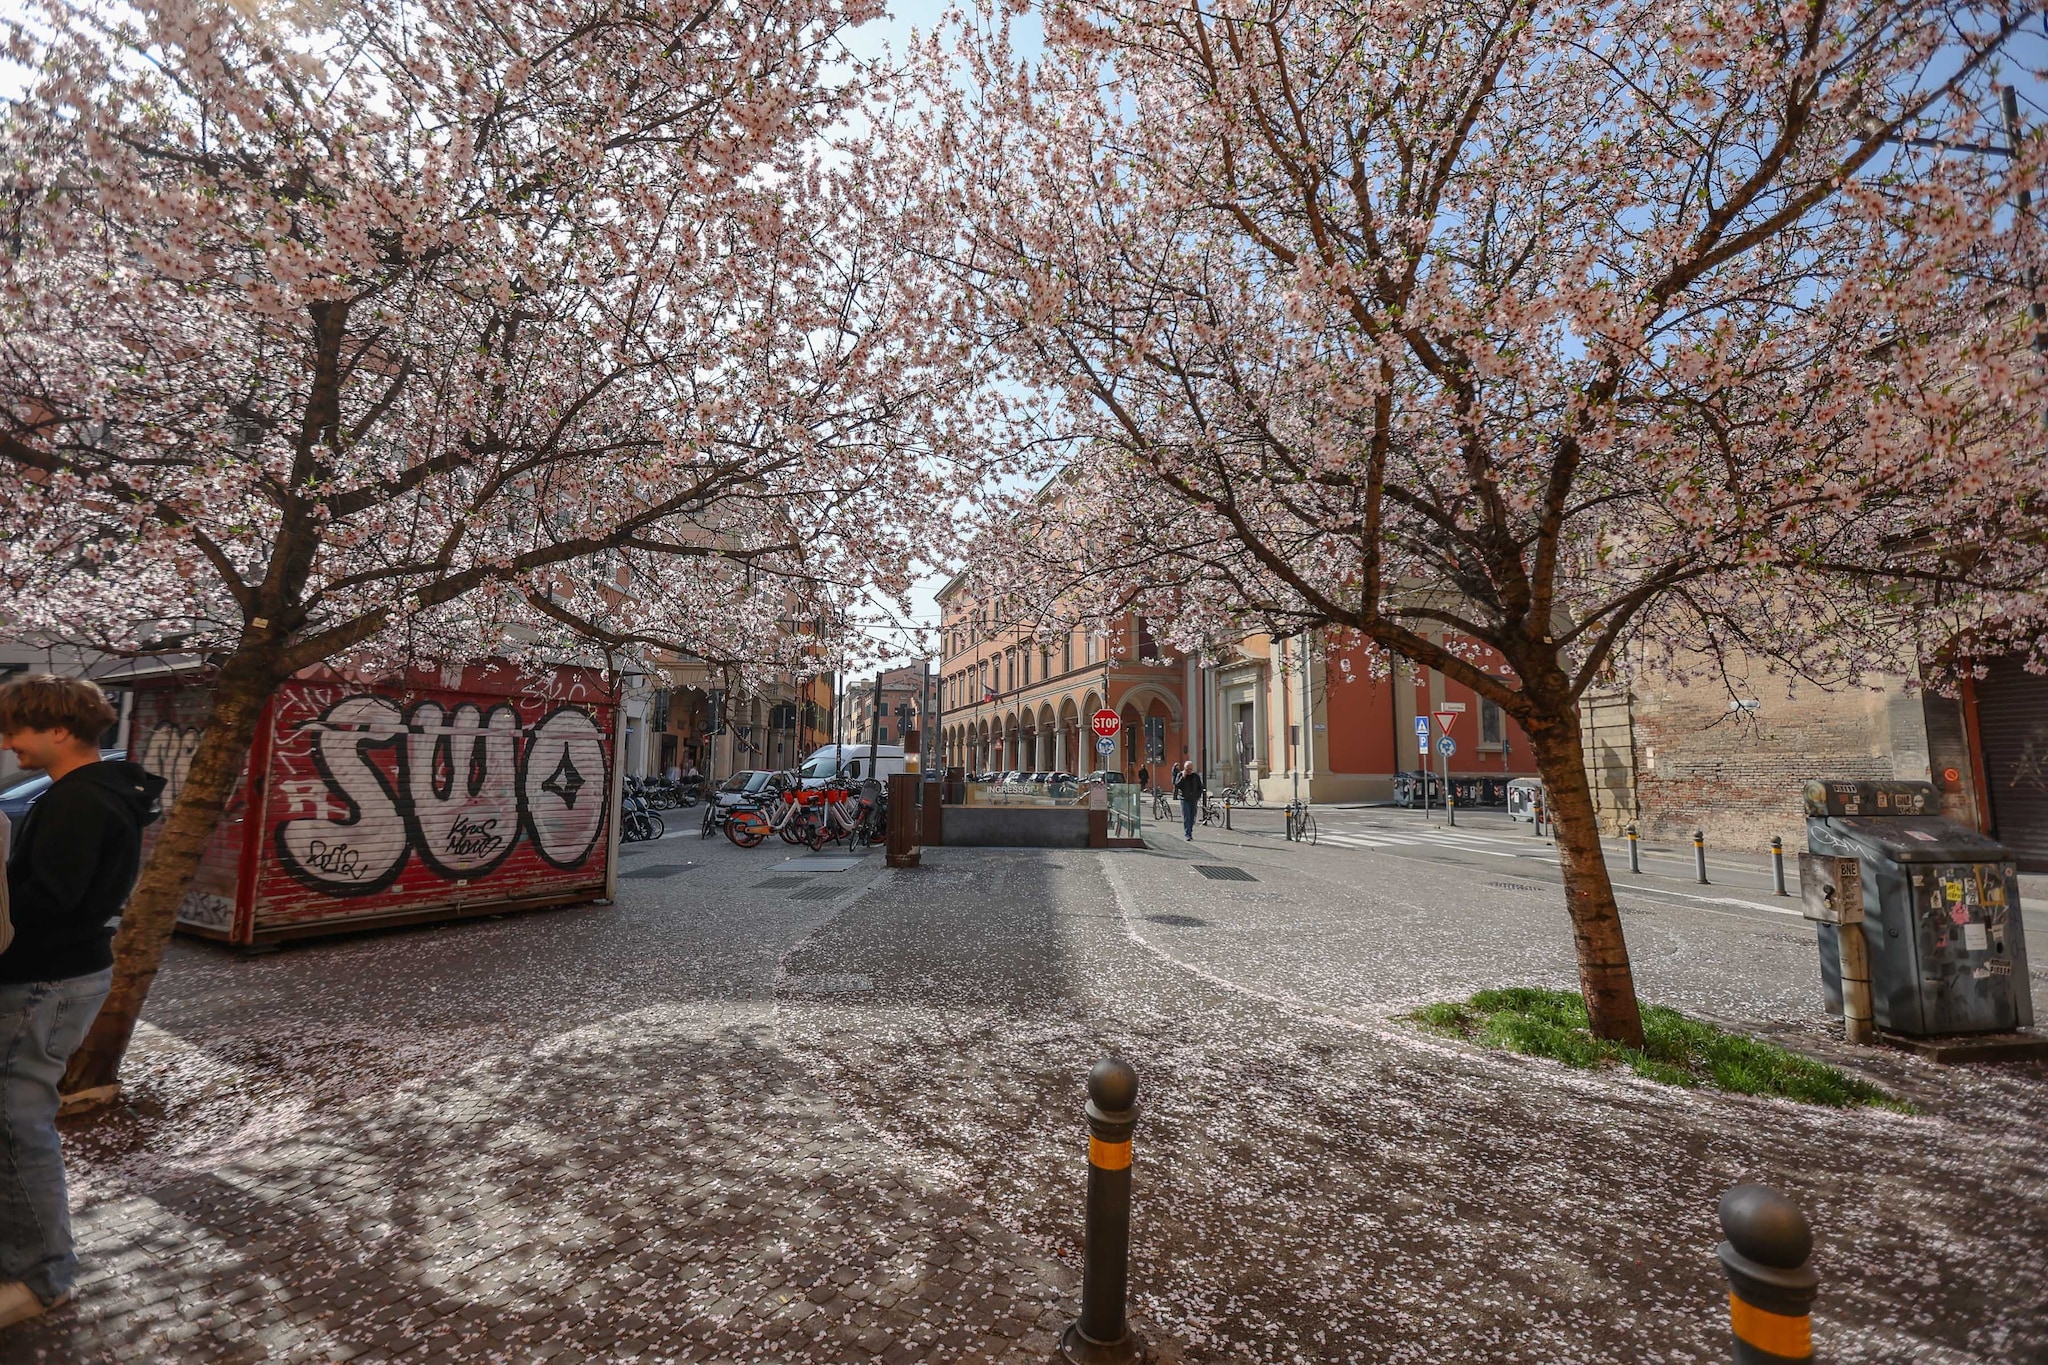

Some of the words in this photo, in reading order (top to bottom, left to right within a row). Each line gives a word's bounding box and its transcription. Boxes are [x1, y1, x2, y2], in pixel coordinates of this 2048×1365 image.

[1094, 717, 1119, 729] STOP
[986, 785, 1030, 794] INGRESSO
[1841, 864, 1856, 875] BNE
